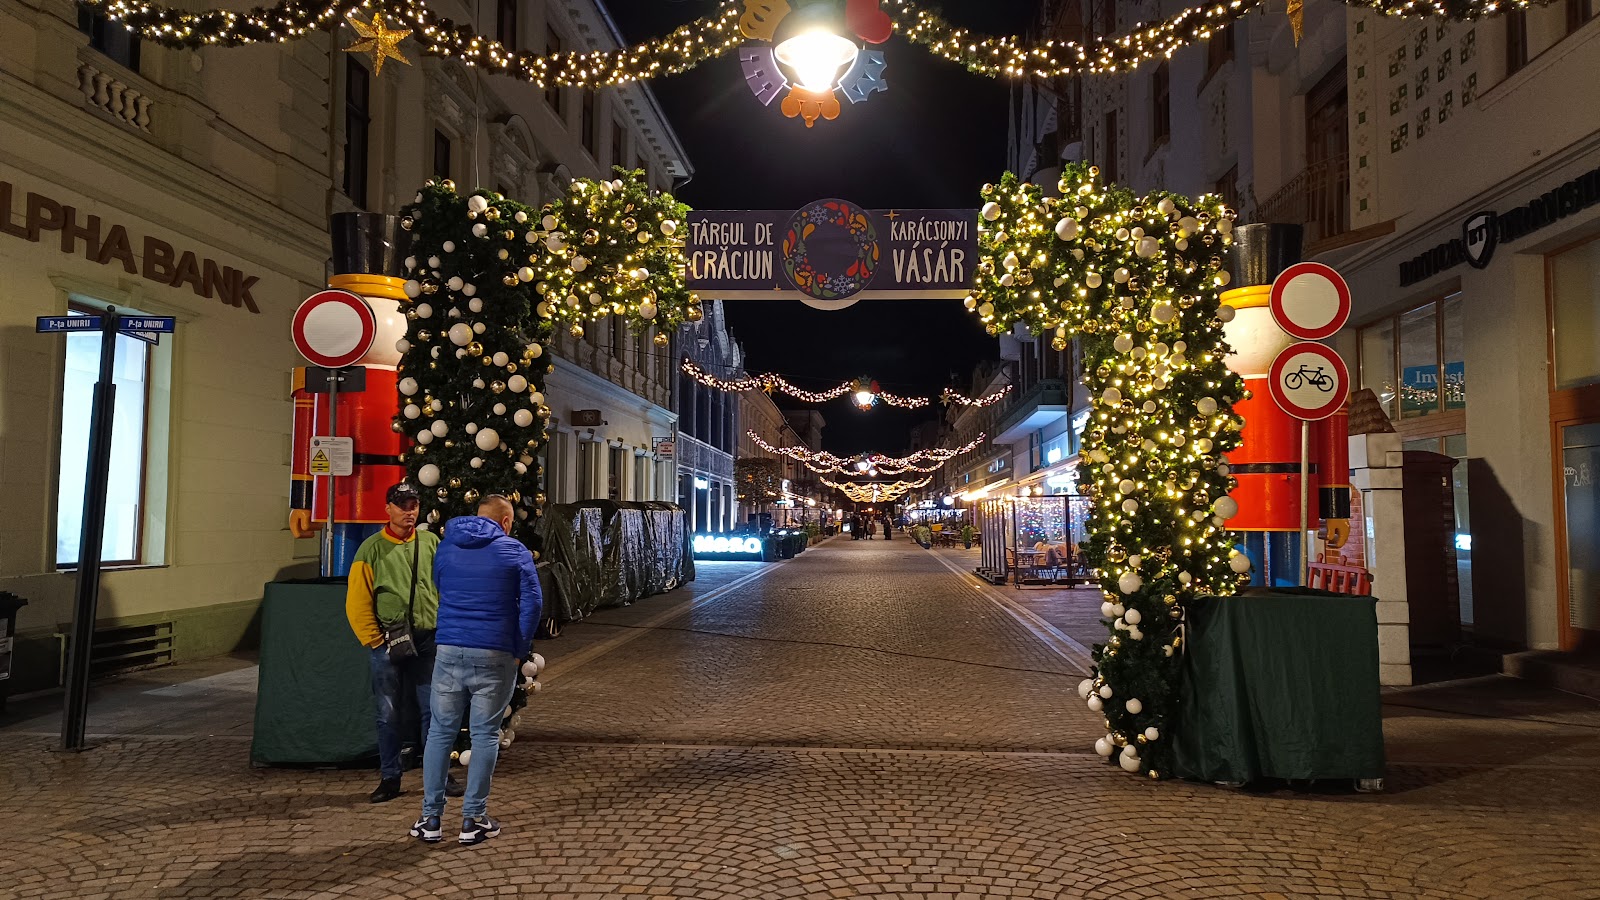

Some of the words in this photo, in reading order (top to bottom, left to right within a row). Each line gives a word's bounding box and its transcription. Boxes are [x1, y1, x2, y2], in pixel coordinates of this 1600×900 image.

[691, 218, 748, 246] TÂRGUL
[755, 222, 774, 246] DE
[890, 217, 968, 242] KARÁCSONYI
[1468, 224, 1486, 246] BT
[691, 246, 774, 281] CRĂCIUN
[892, 240, 965, 283] VÁSÁR
[142, 235, 261, 314] BANK
[66, 319, 91, 328] UNIRII
[143, 320, 164, 329] UNIRII
[1415, 370, 1465, 384] Invest
